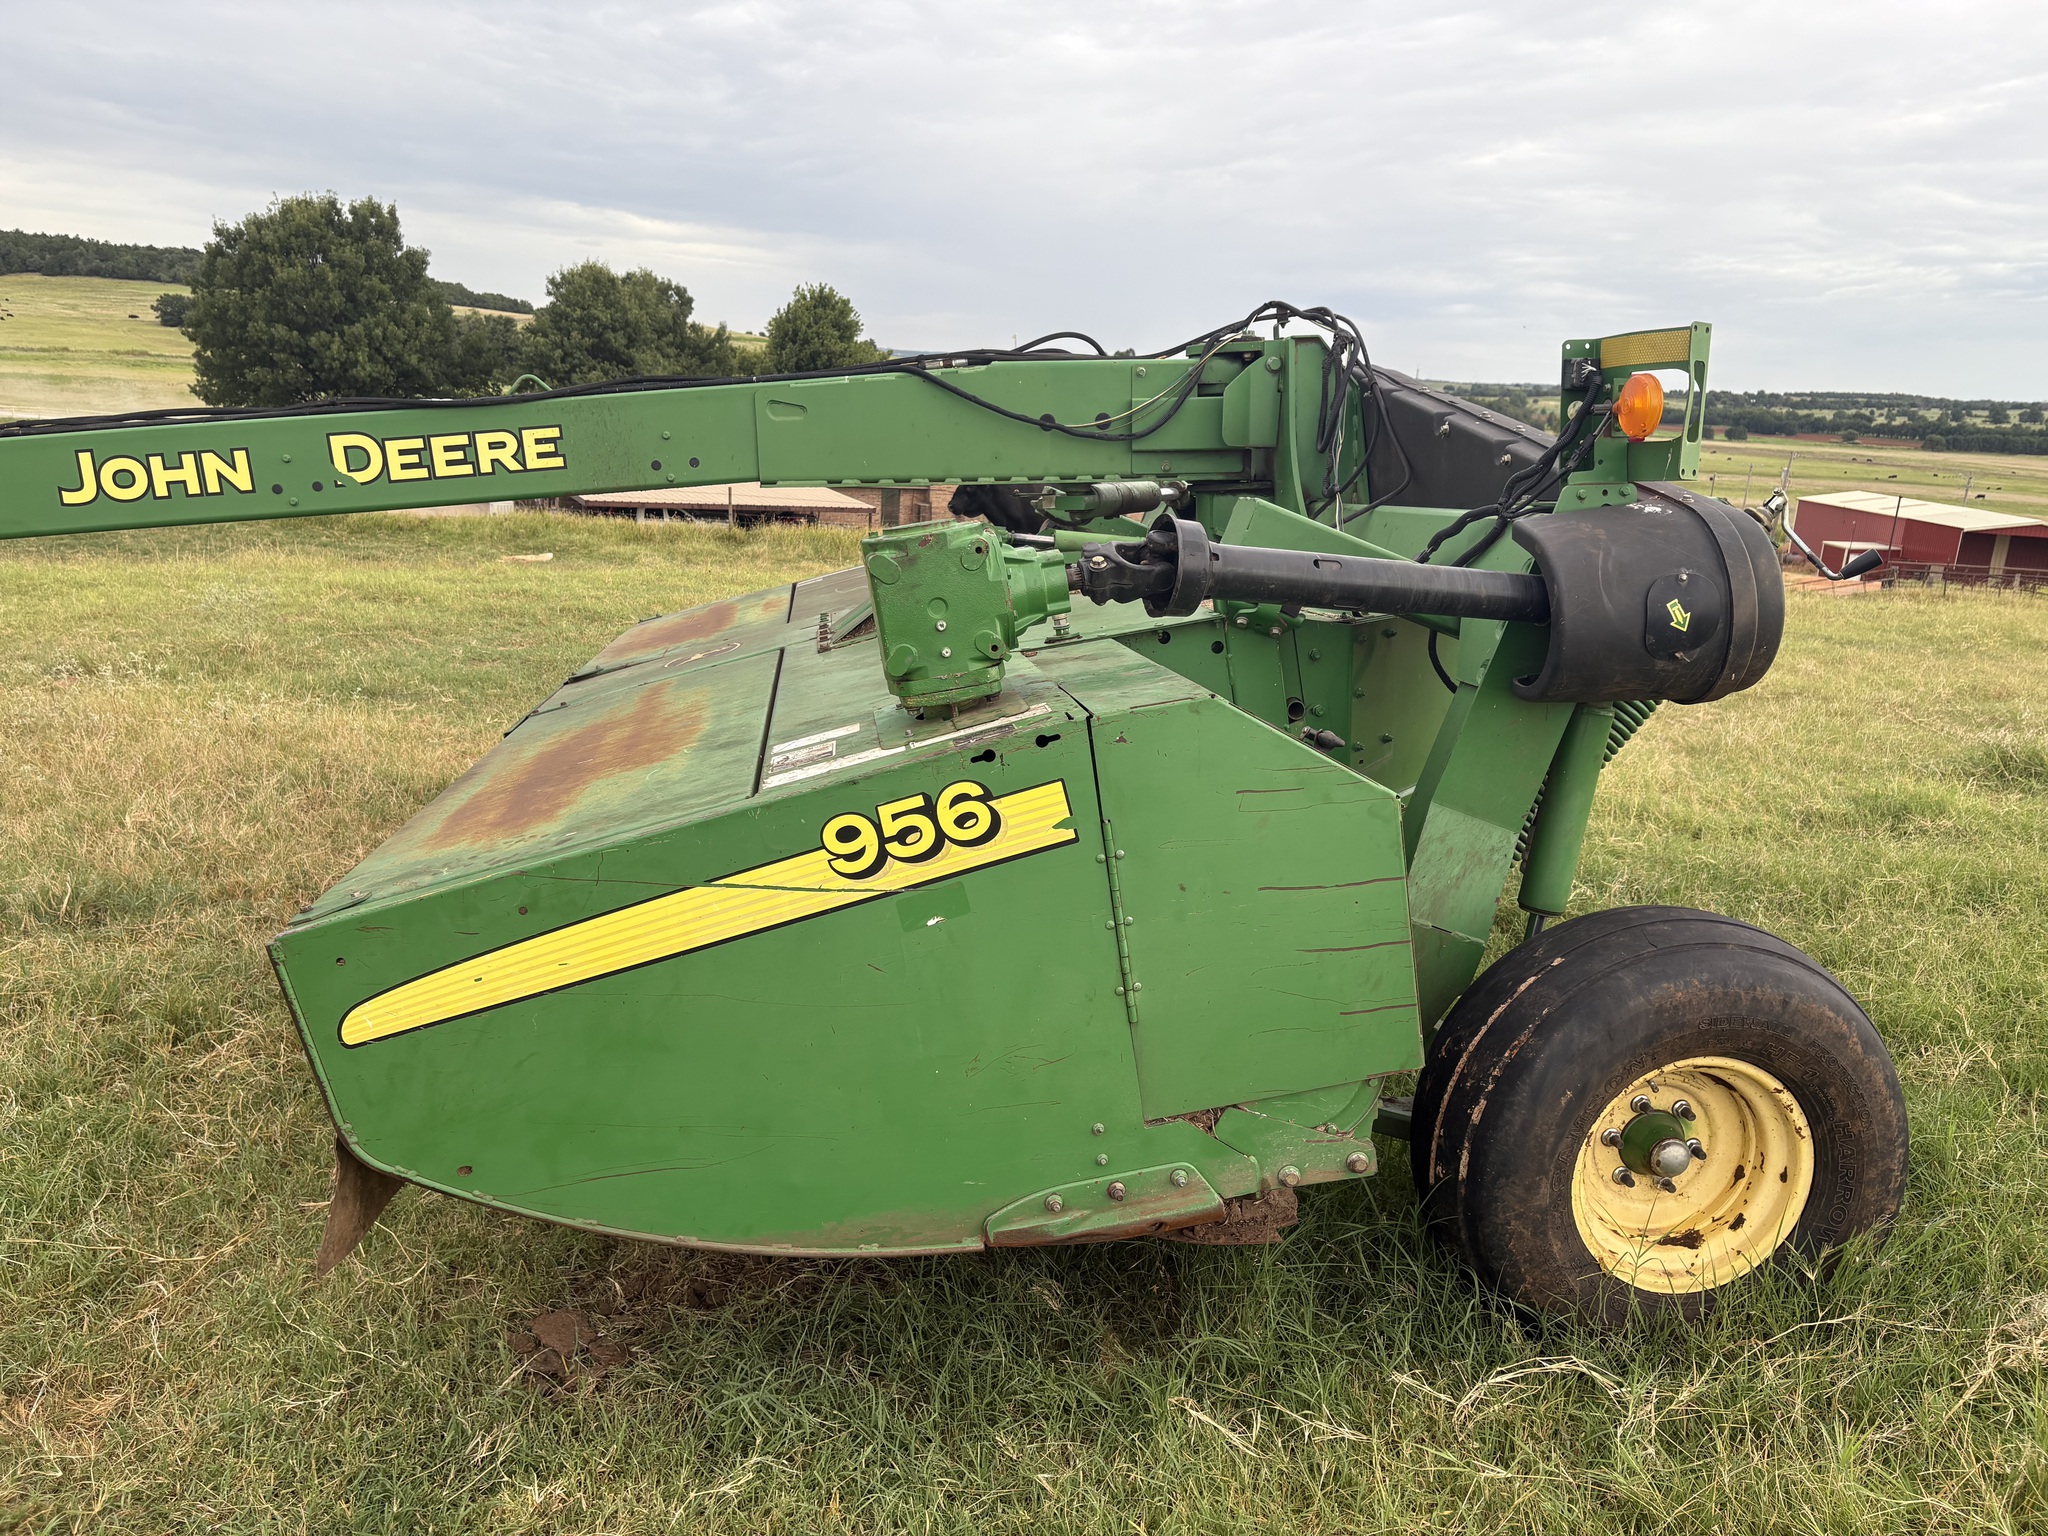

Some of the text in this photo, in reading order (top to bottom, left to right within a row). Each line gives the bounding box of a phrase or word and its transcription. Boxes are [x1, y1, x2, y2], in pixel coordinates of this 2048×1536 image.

[59, 424, 567, 507] JOHN DEERE
[820, 779, 1002, 880] 956
[1698, 1015, 1874, 1135] SIDEWALL PROTECTION
